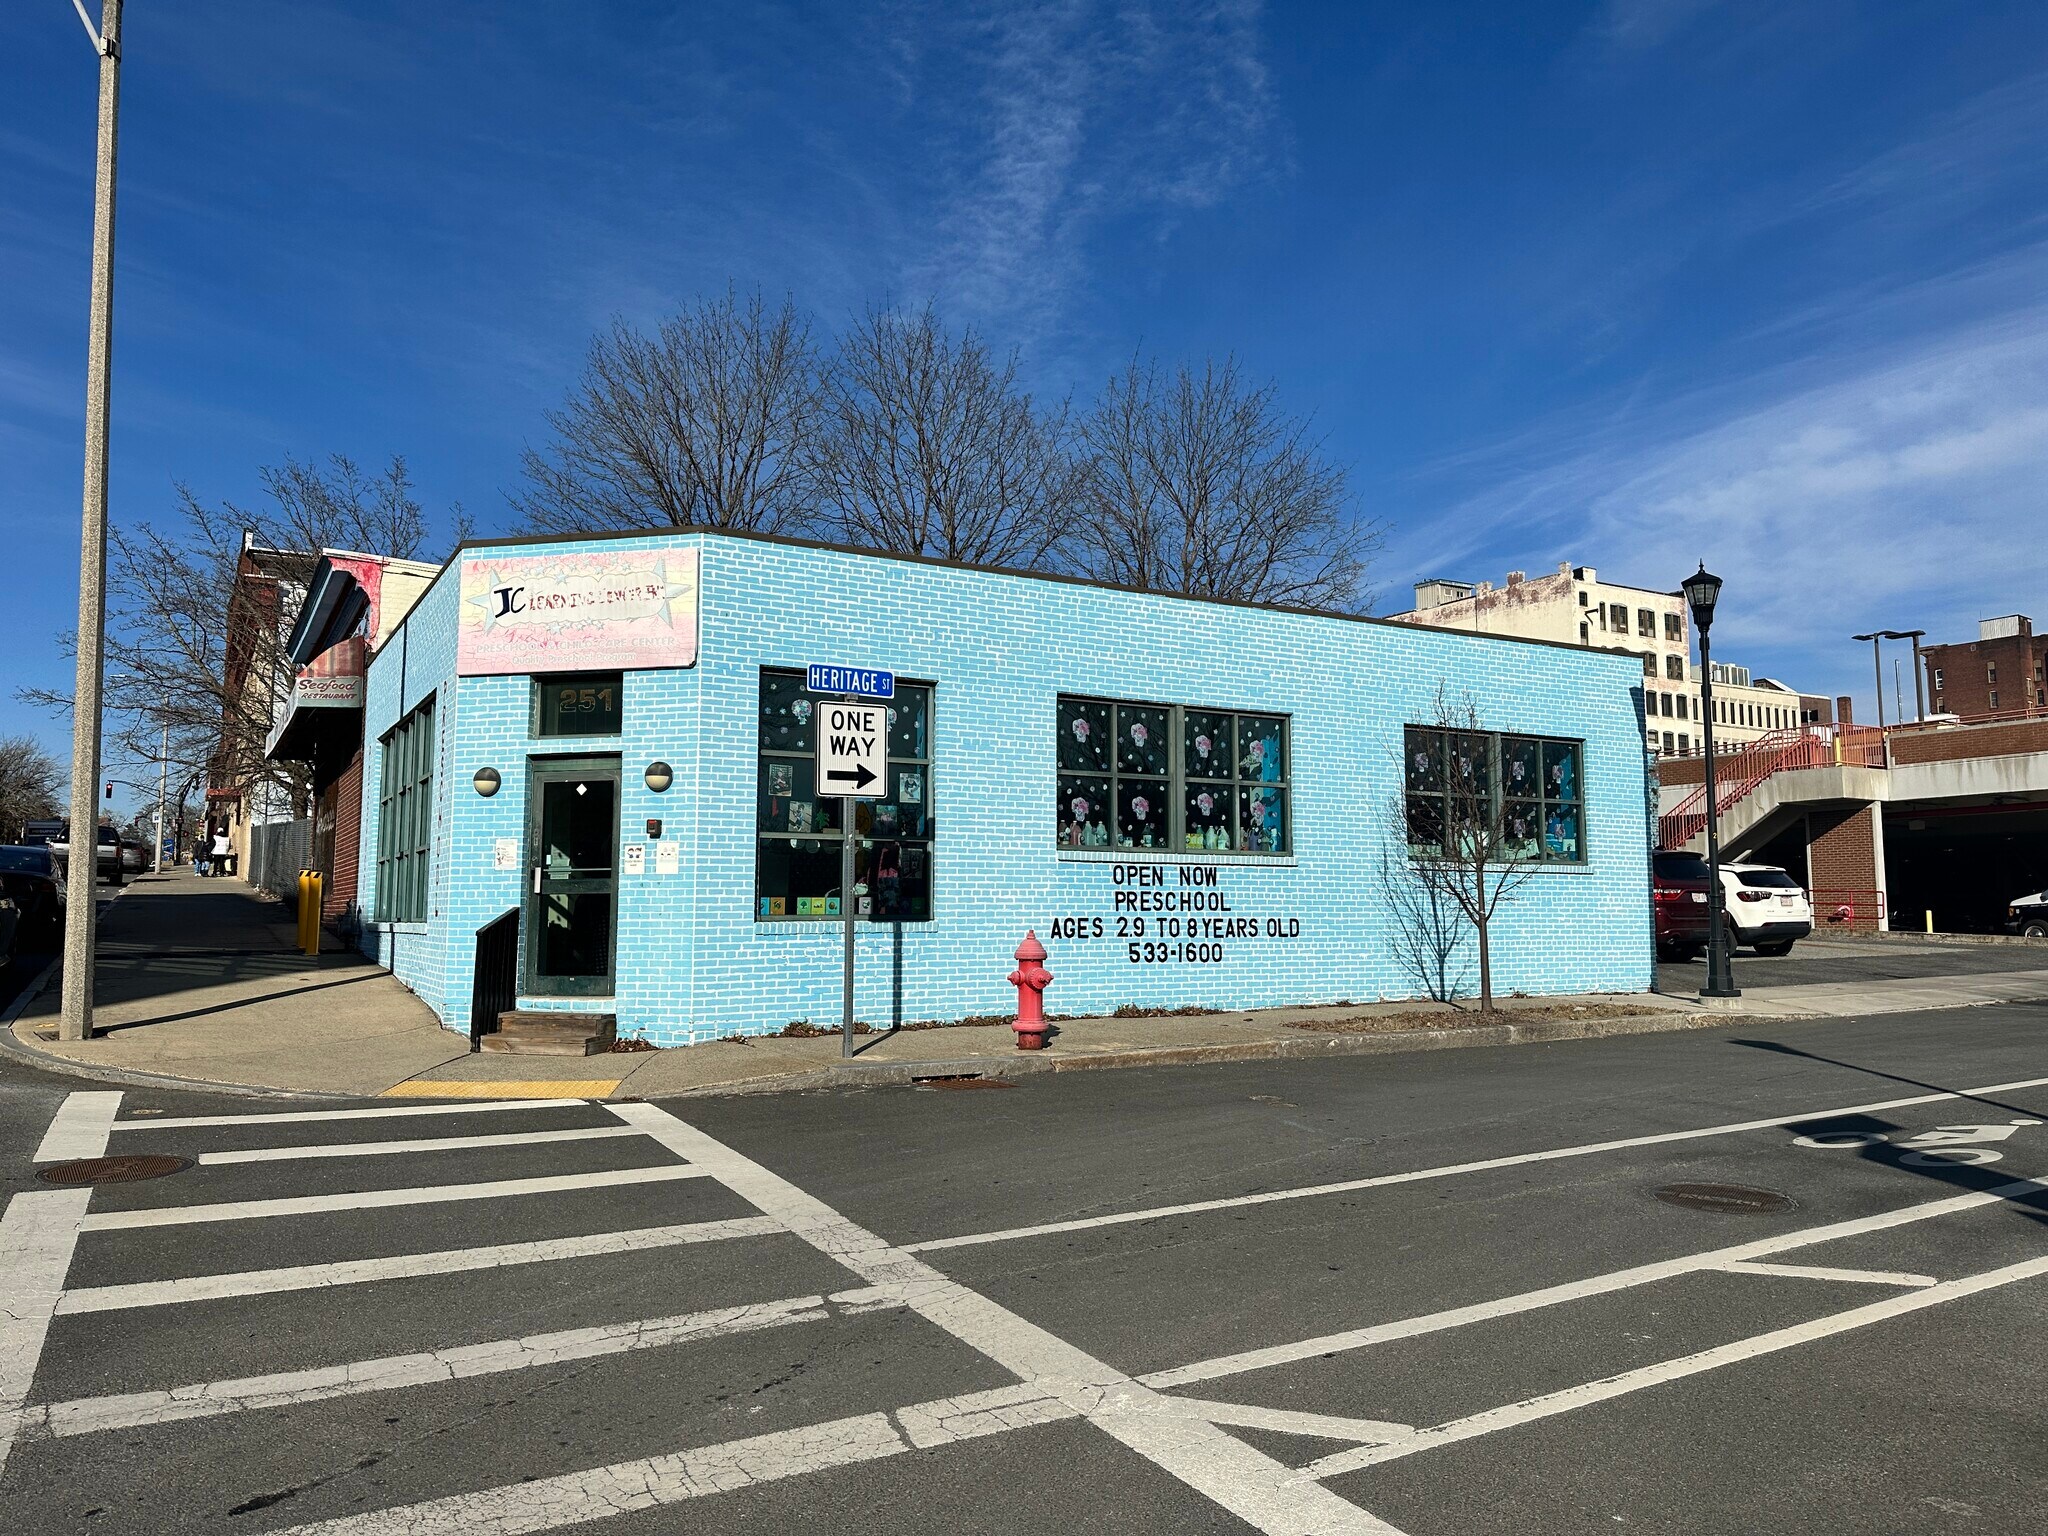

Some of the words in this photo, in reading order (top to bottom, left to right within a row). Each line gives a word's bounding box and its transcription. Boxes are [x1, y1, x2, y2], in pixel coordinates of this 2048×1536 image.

[299, 680, 358, 692] Seafood
[811, 667, 878, 692] HERITAGE
[882, 678, 890, 690] ST
[560, 688, 612, 712] 251
[831, 710, 875, 732] ONE
[830, 735, 876, 757] WAY
[1112, 865, 1164, 886] OPEN
[1179, 866, 1217, 887] NOW
[1115, 891, 1232, 911] PRESCHOOL
[1050, 917, 1103, 939] AGES
[1116, 917, 1145, 937] 2.9
[1157, 917, 1180, 937] TO
[1202, 918, 1259, 938] YEARS
[1267, 918, 1300, 938] OLD
[1128, 942, 1222, 963] 533-1600
